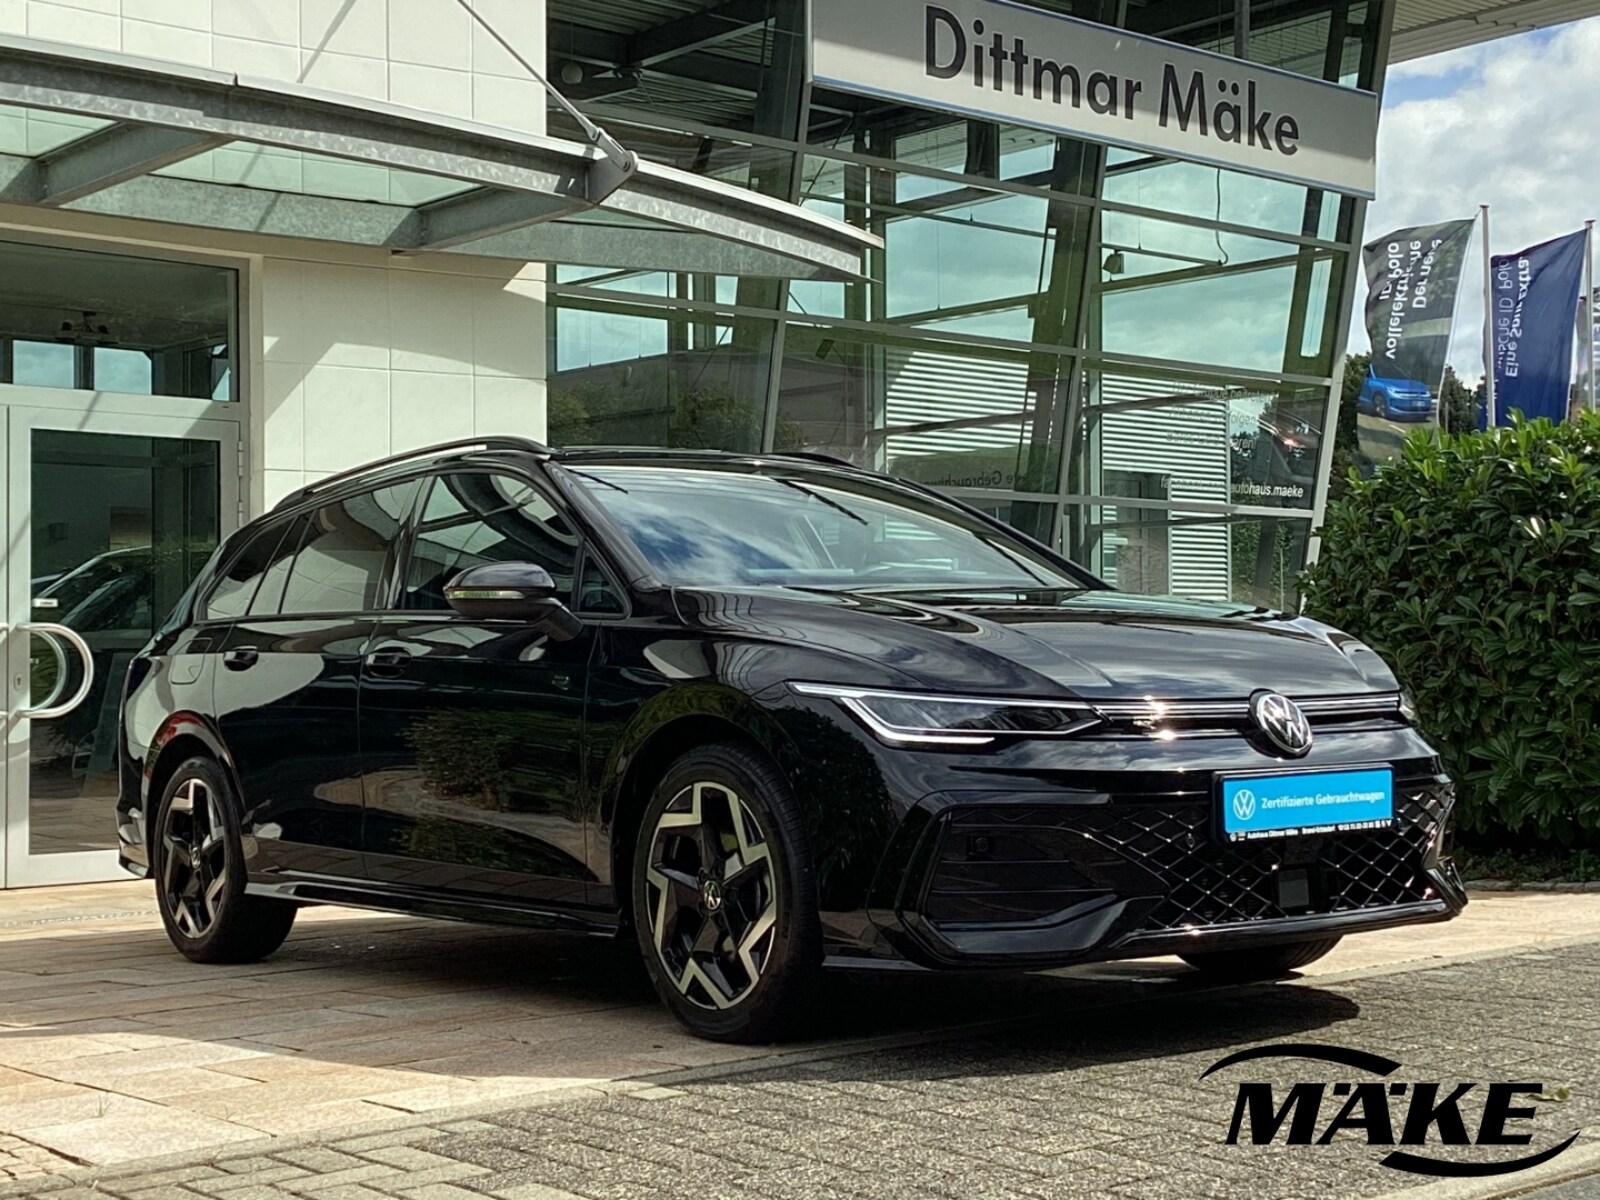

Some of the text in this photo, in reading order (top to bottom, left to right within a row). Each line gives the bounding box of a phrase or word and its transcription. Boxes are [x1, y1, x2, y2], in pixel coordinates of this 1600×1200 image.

[925, 5, 1300, 156] Dittmar Mäke
[1261, 796, 1314, 809] Zertifizierte
[1315, 791, 1385, 806] Gebrauchtwagen
